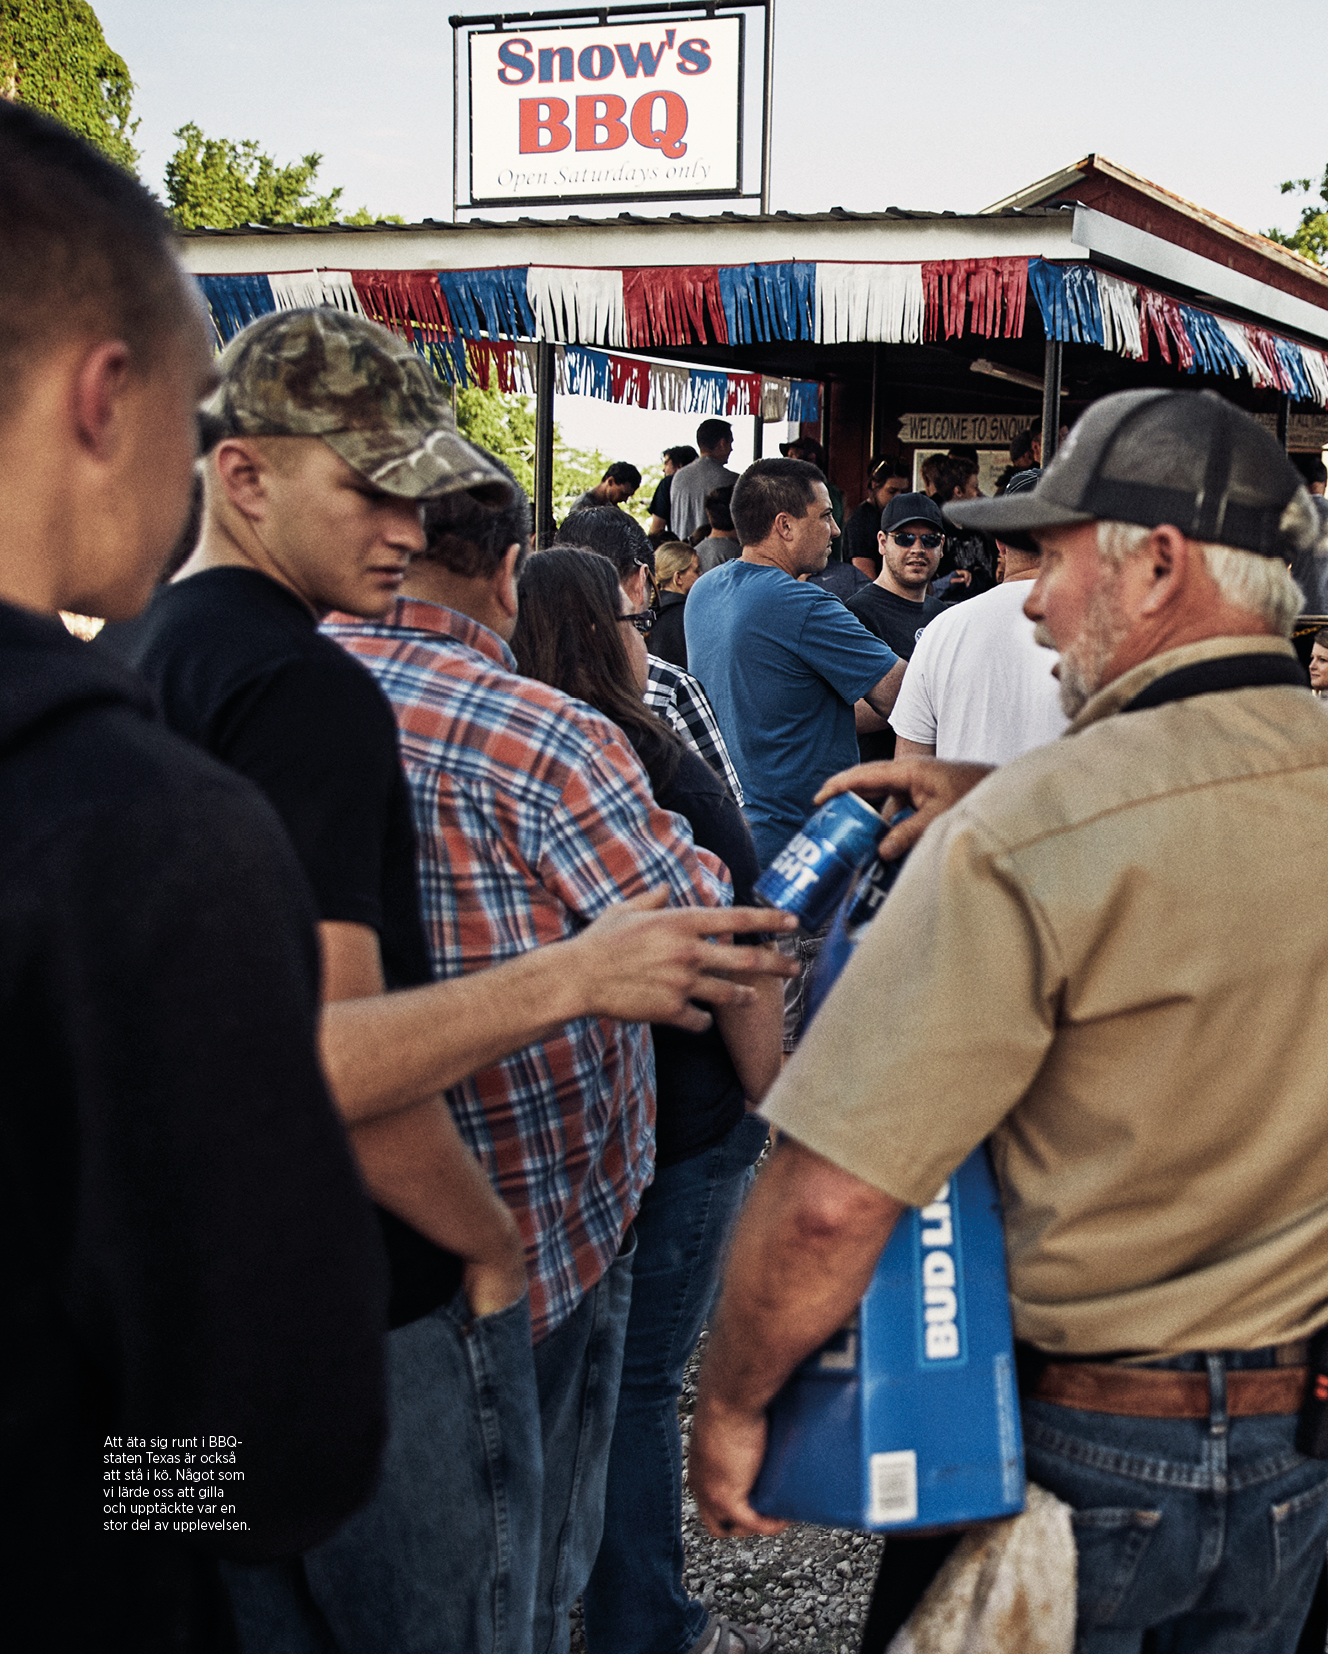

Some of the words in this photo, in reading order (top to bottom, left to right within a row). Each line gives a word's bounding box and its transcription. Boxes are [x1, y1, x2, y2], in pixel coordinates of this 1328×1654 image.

[497, 28, 712, 86] Snow's
[518, 90, 689, 160] BBQ
[497, 168, 547, 192] Open
[554, 161, 659, 188] Saturdays
[665, 157, 711, 185] only
[909, 416, 968, 440] WELCOME
[971, 416, 987, 440] TO
[922, 1250, 959, 1360] BUD
